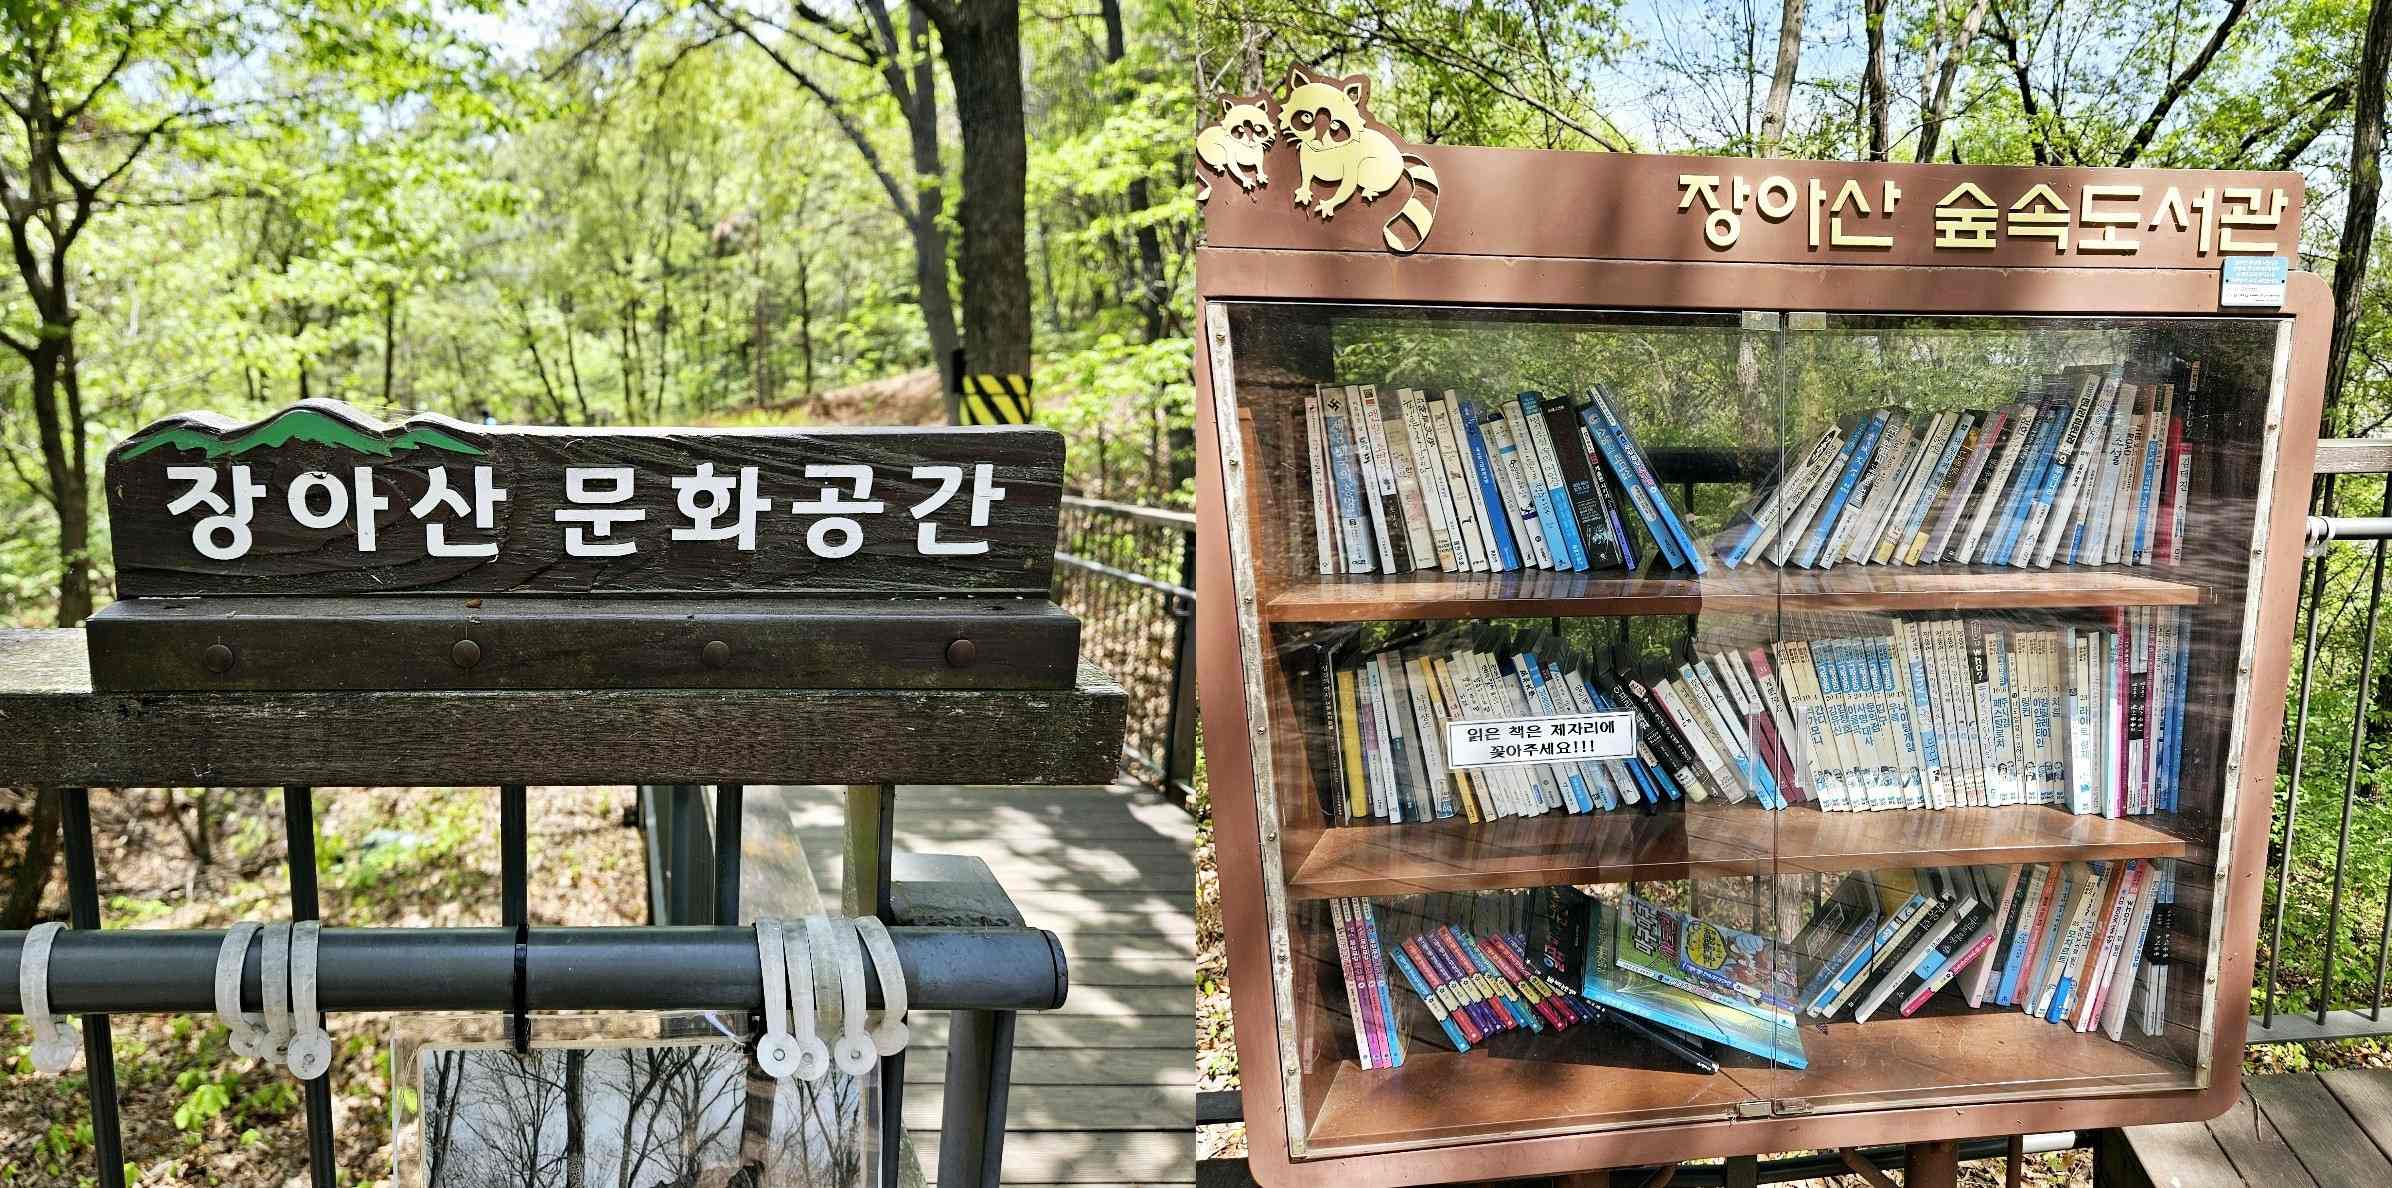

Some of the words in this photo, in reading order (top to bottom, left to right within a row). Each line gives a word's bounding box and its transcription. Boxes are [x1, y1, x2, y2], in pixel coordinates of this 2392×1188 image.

[1677, 173, 1902, 249] 장아산
[1933, 181, 2289, 253] 숲속도서관
[166, 463, 508, 561] 장아산
[554, 460, 1007, 558] 문화공간
[1467, 727, 1501, 742] 읽은
[1508, 724, 1542, 740] 책은
[1550, 719, 1616, 737] 제자리에
[1489, 739, 1595, 760] 꽂아주세요!!!
